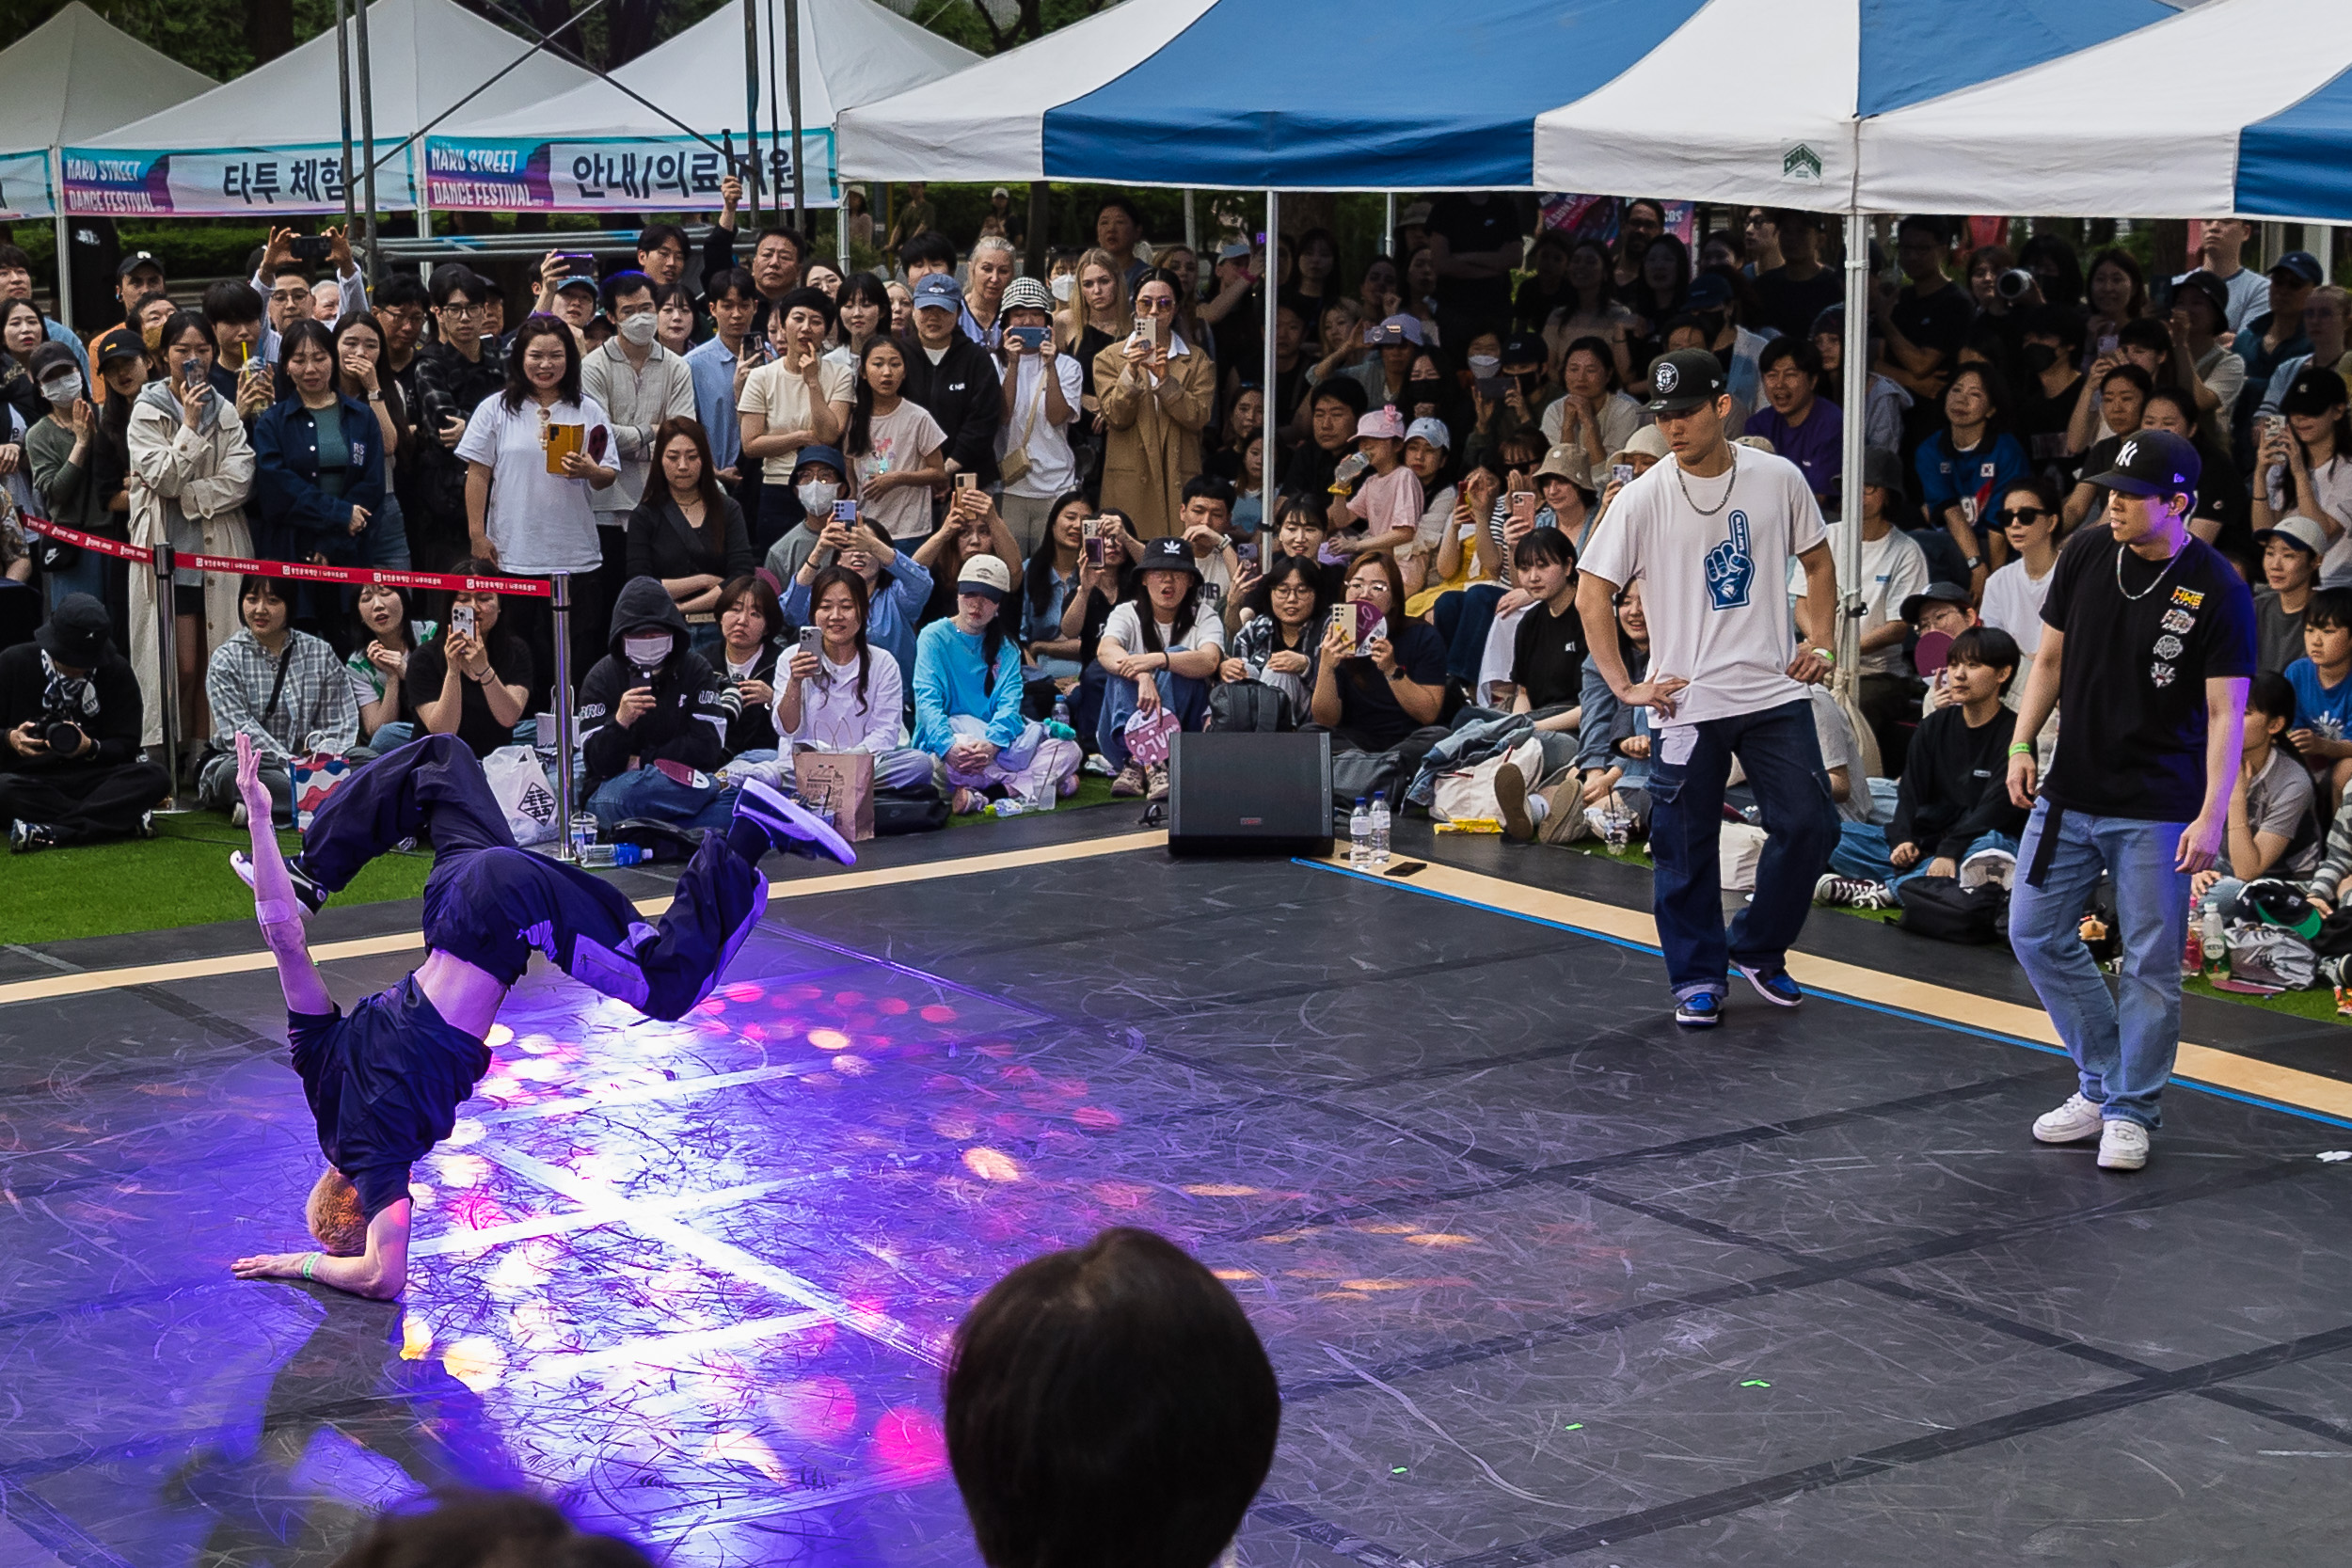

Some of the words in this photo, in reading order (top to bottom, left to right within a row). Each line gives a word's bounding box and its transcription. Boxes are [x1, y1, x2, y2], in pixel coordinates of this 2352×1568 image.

[99, 160, 141, 182] STREET
[432, 149, 466, 172] NARU
[469, 150, 517, 173] STREET
[223, 162, 281, 204] 타투
[290, 156, 345, 202] 체험
[572, 150, 723, 198] 안내/의료
[69, 190, 104, 212] DANCE
[104, 191, 156, 212] FESTIVAL
[433, 182, 473, 205] DANCE
[475, 182, 532, 206] FESTIVAL
